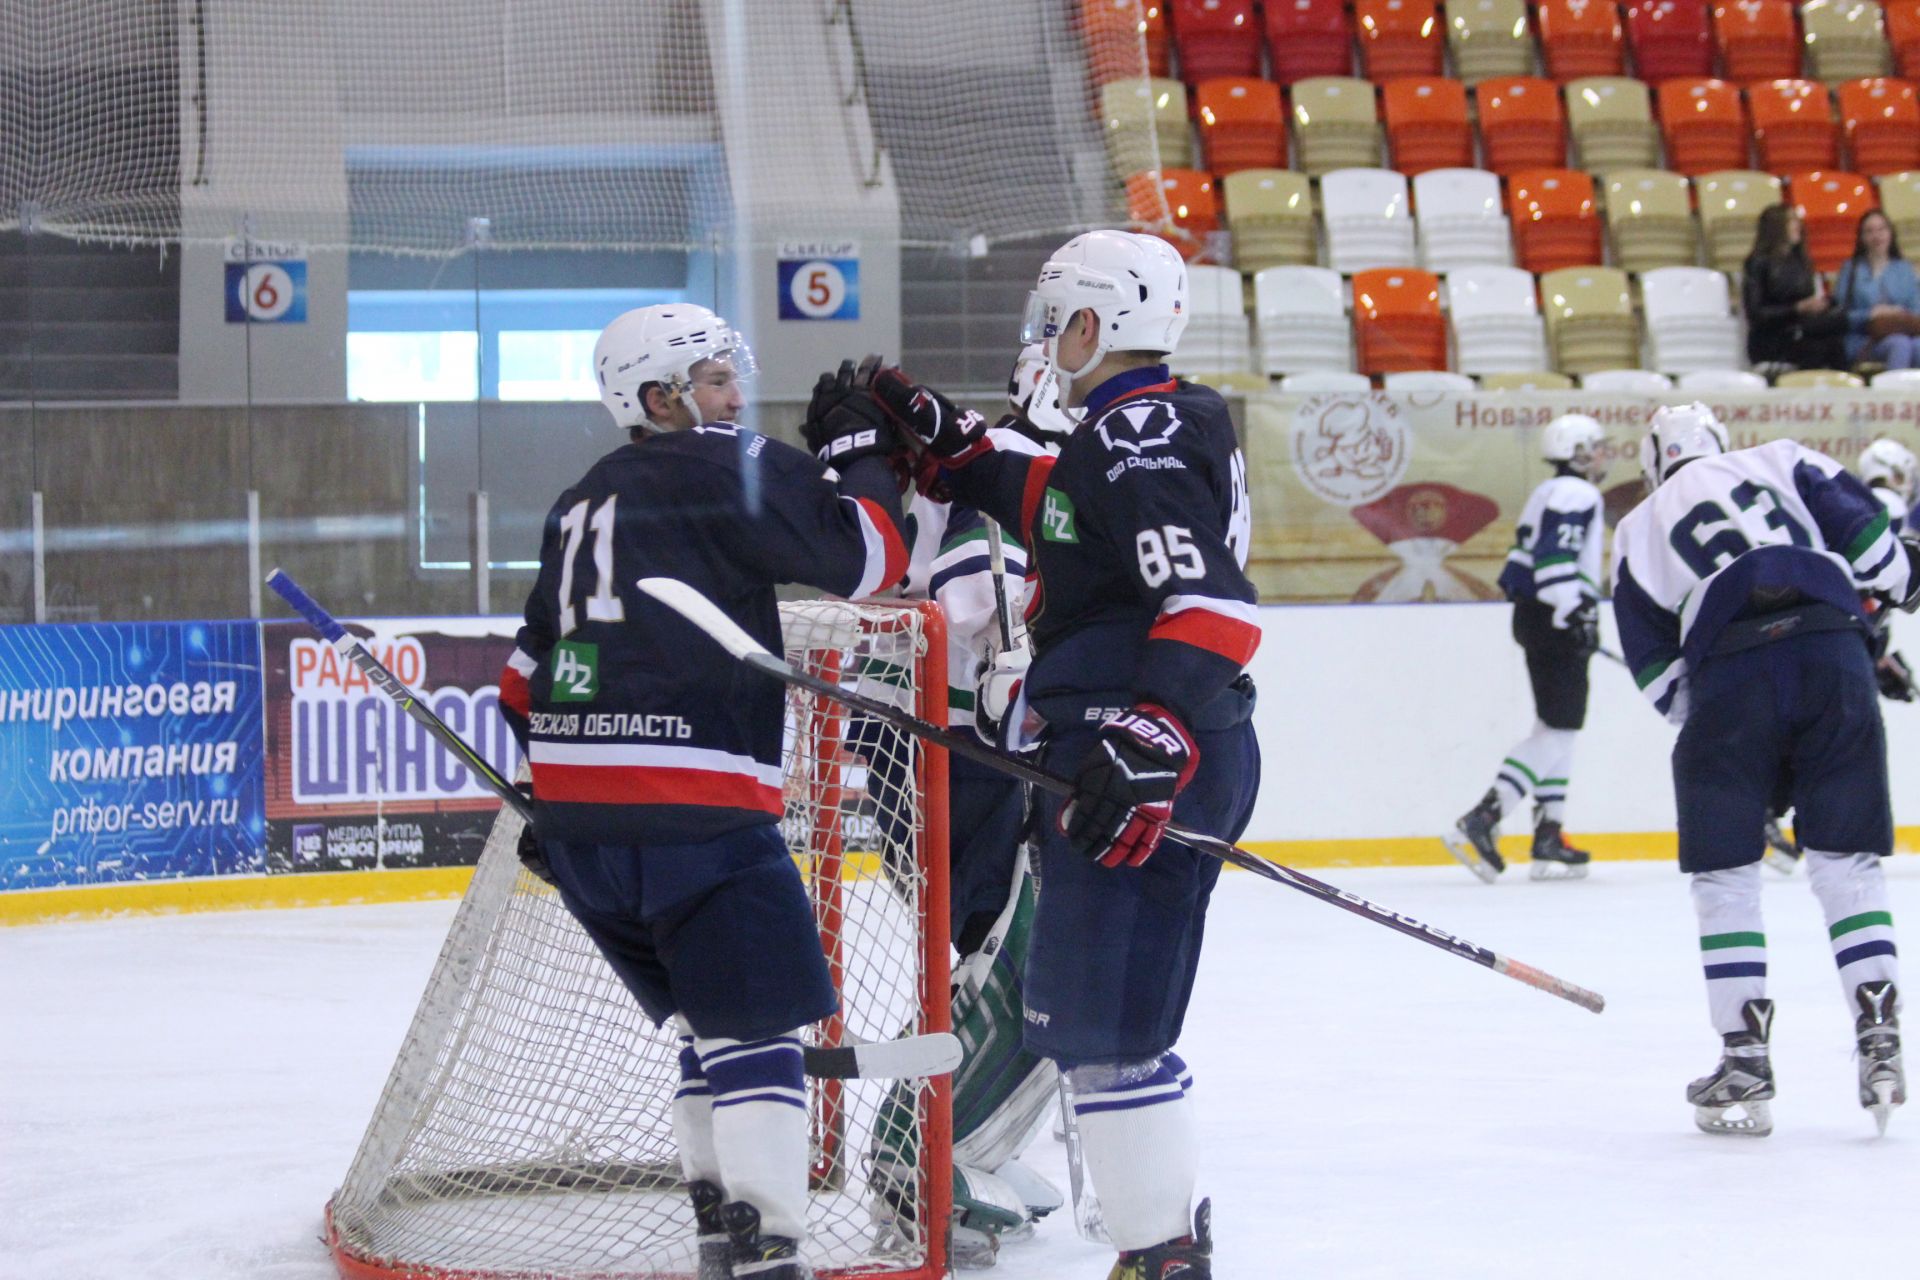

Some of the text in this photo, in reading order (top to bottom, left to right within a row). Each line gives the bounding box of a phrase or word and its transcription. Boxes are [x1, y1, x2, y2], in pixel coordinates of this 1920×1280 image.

[254, 272, 278, 310] 6
[807, 271, 831, 307] 5
[1455, 400, 1553, 428] Новая
[1557, 523, 1584, 552] 25
[1669, 479, 1813, 581] 63
[558, 493, 626, 640] 71
[1136, 524, 1206, 589] 85
[298, 693, 526, 796] ШАНСО
[529, 712, 692, 739] ВСКАЯ ОБЛАСТЬ
[50, 741, 238, 782] компания
[51, 798, 239, 843] pribor-serv.ru
